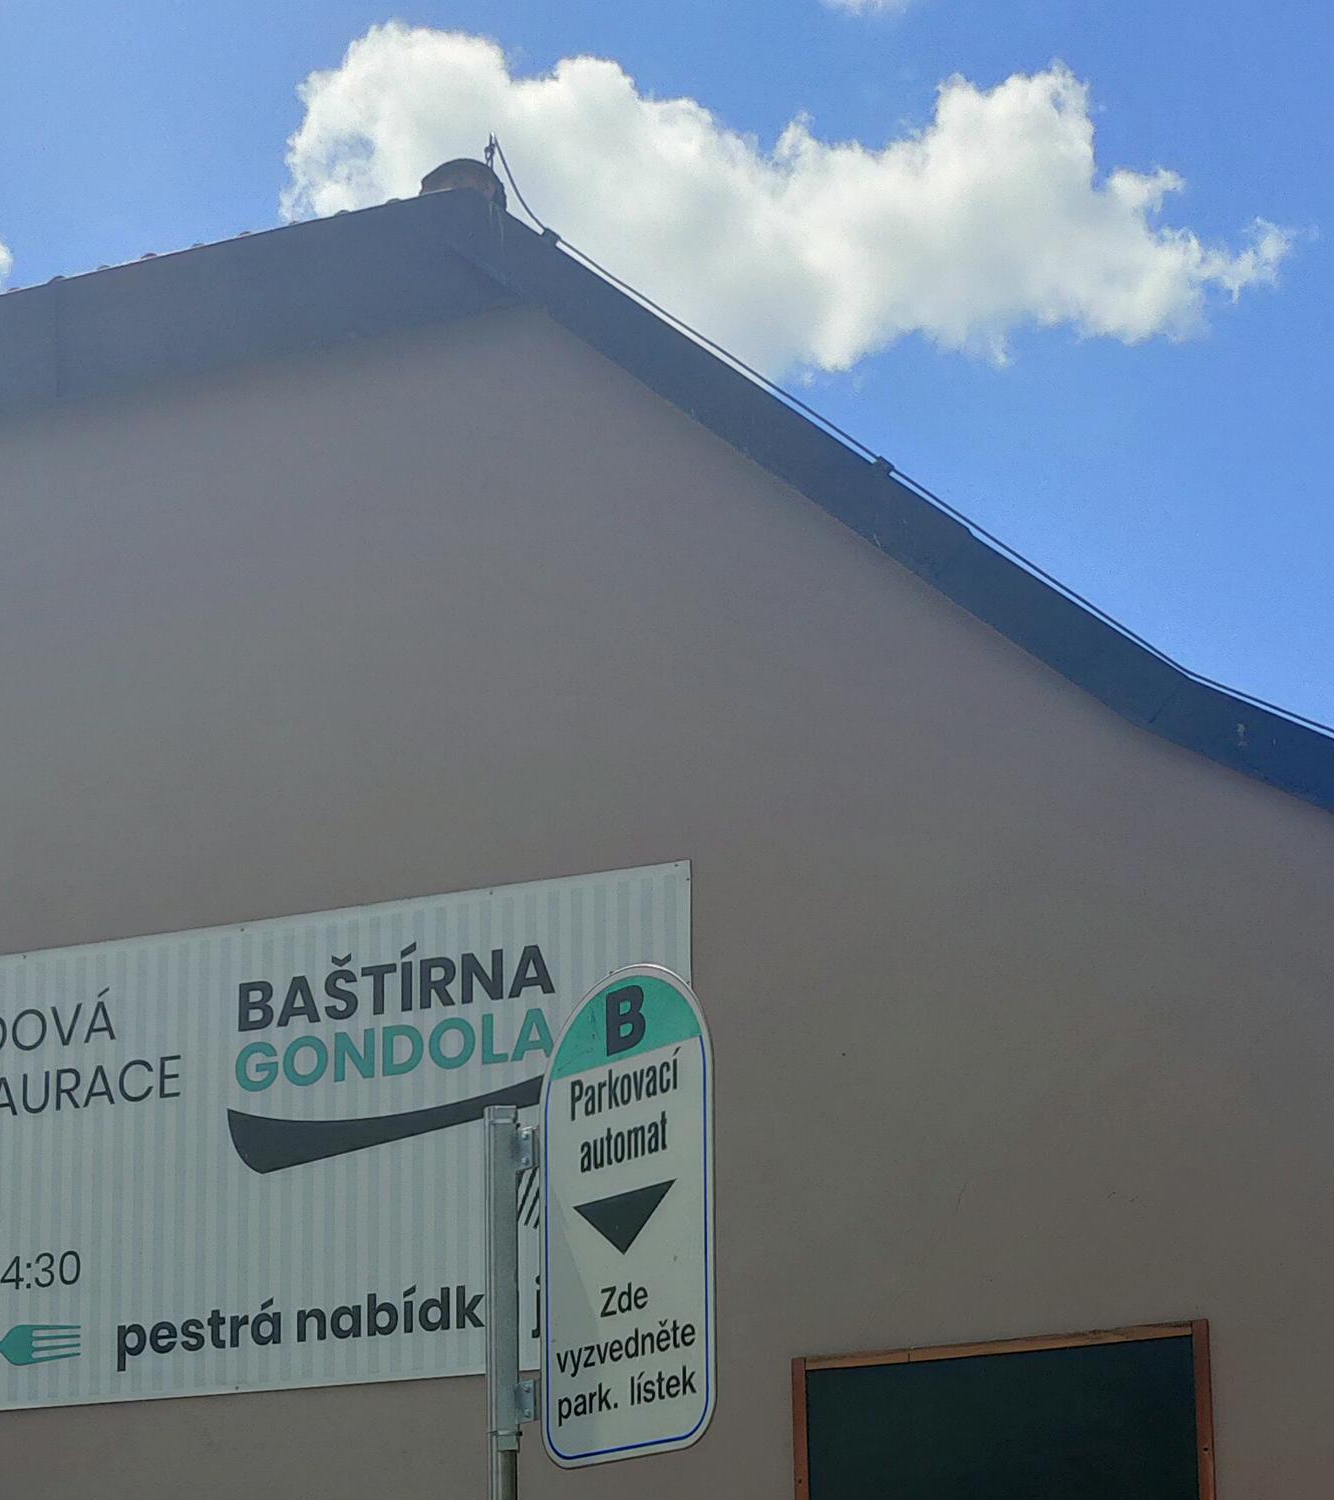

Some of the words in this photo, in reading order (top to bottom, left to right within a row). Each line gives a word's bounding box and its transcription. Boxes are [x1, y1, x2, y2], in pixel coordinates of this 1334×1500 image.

[238, 941, 556, 1032] BAŠTÍRNA
[605, 984, 646, 1057] B
[235, 1007, 555, 1093] GONDOLA
[570, 1046, 682, 1122] Parkovací
[580, 1110, 668, 1174] automat
[116, 1296, 282, 1372] pestrá
[296, 1284, 486, 1343] nabídk
[600, 1281, 649, 1318] Zde
[556, 1318, 696, 1378] vyzvedněte
[557, 1382, 619, 1427] park.
[630, 1365, 697, 1406] lístek
